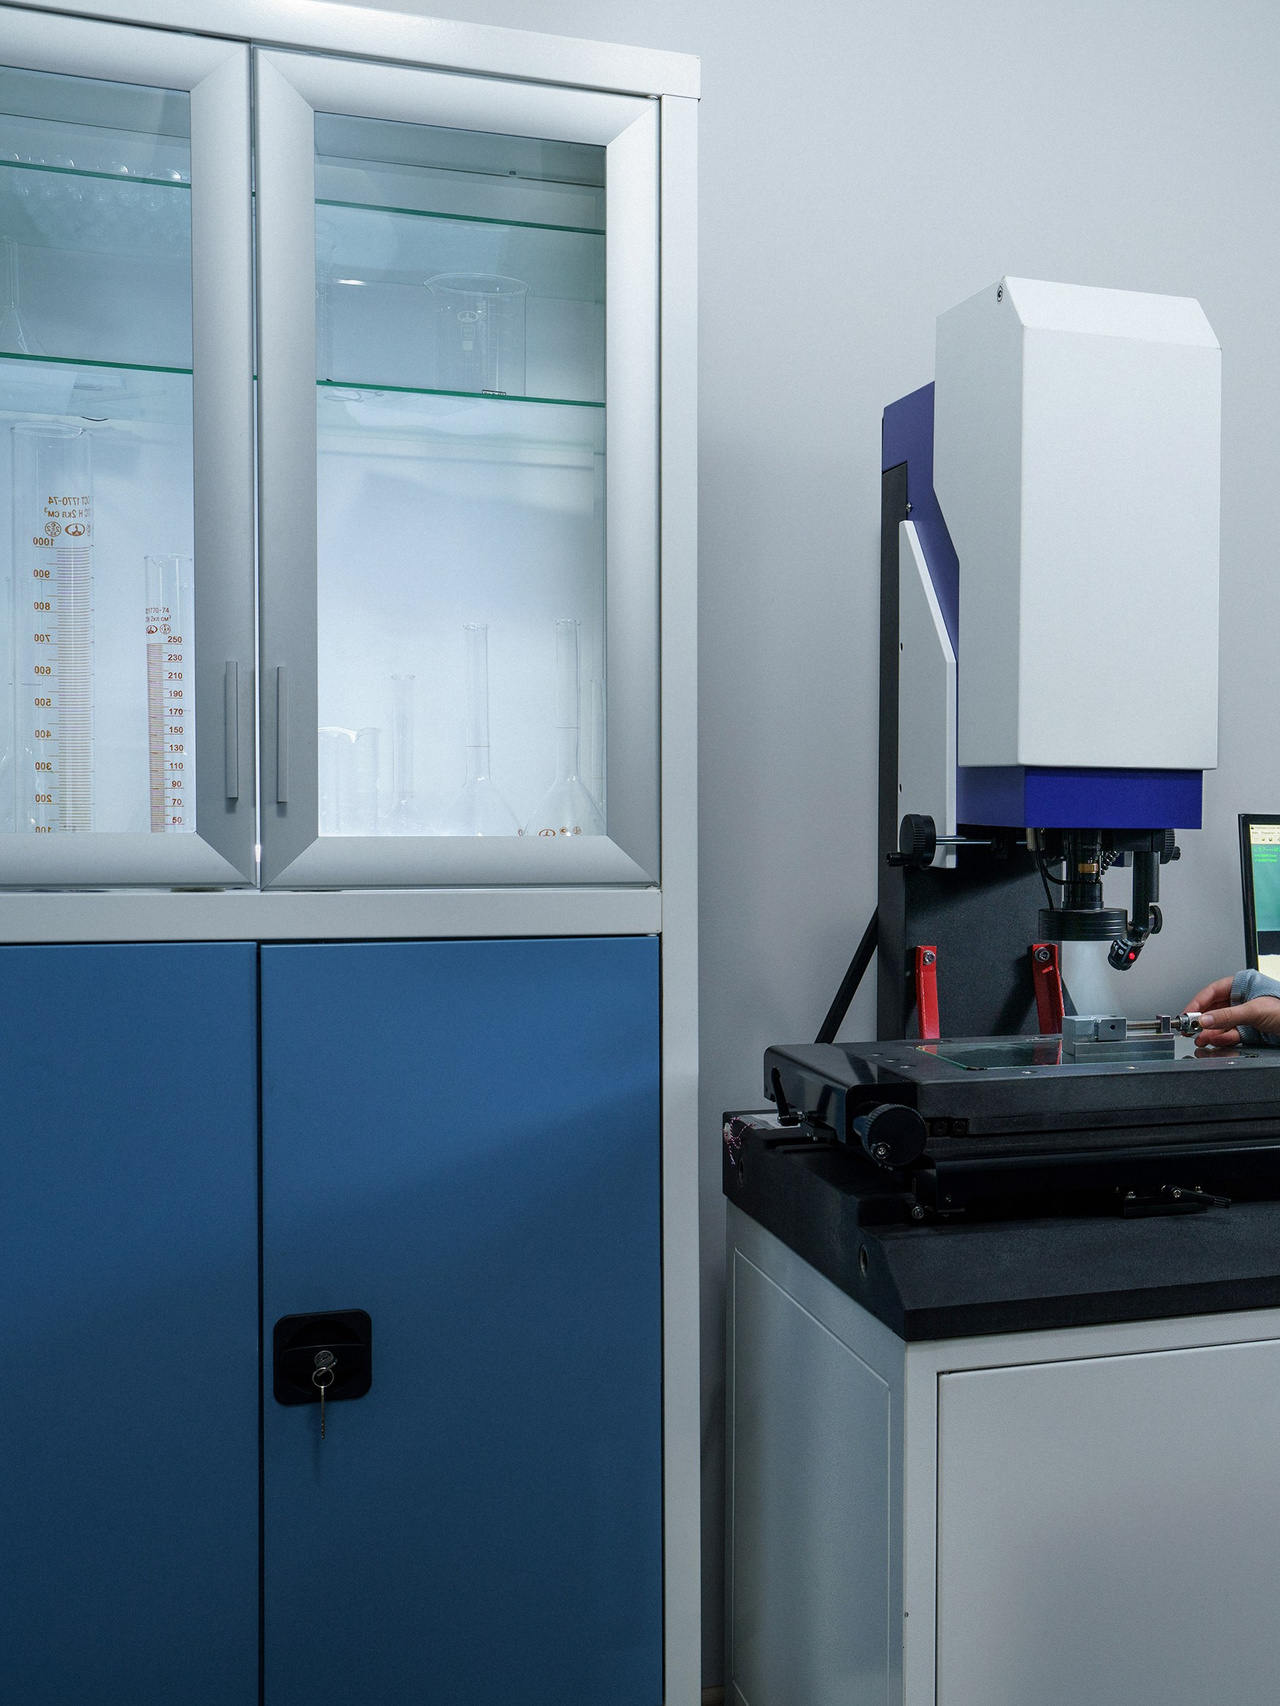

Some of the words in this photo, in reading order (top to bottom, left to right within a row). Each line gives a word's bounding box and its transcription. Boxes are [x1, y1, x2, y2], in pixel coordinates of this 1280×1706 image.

[168, 708, 184, 716] 170
[171, 780, 182, 788] 90
[172, 798, 182, 806] 70
[172, 816, 183, 824] 50
